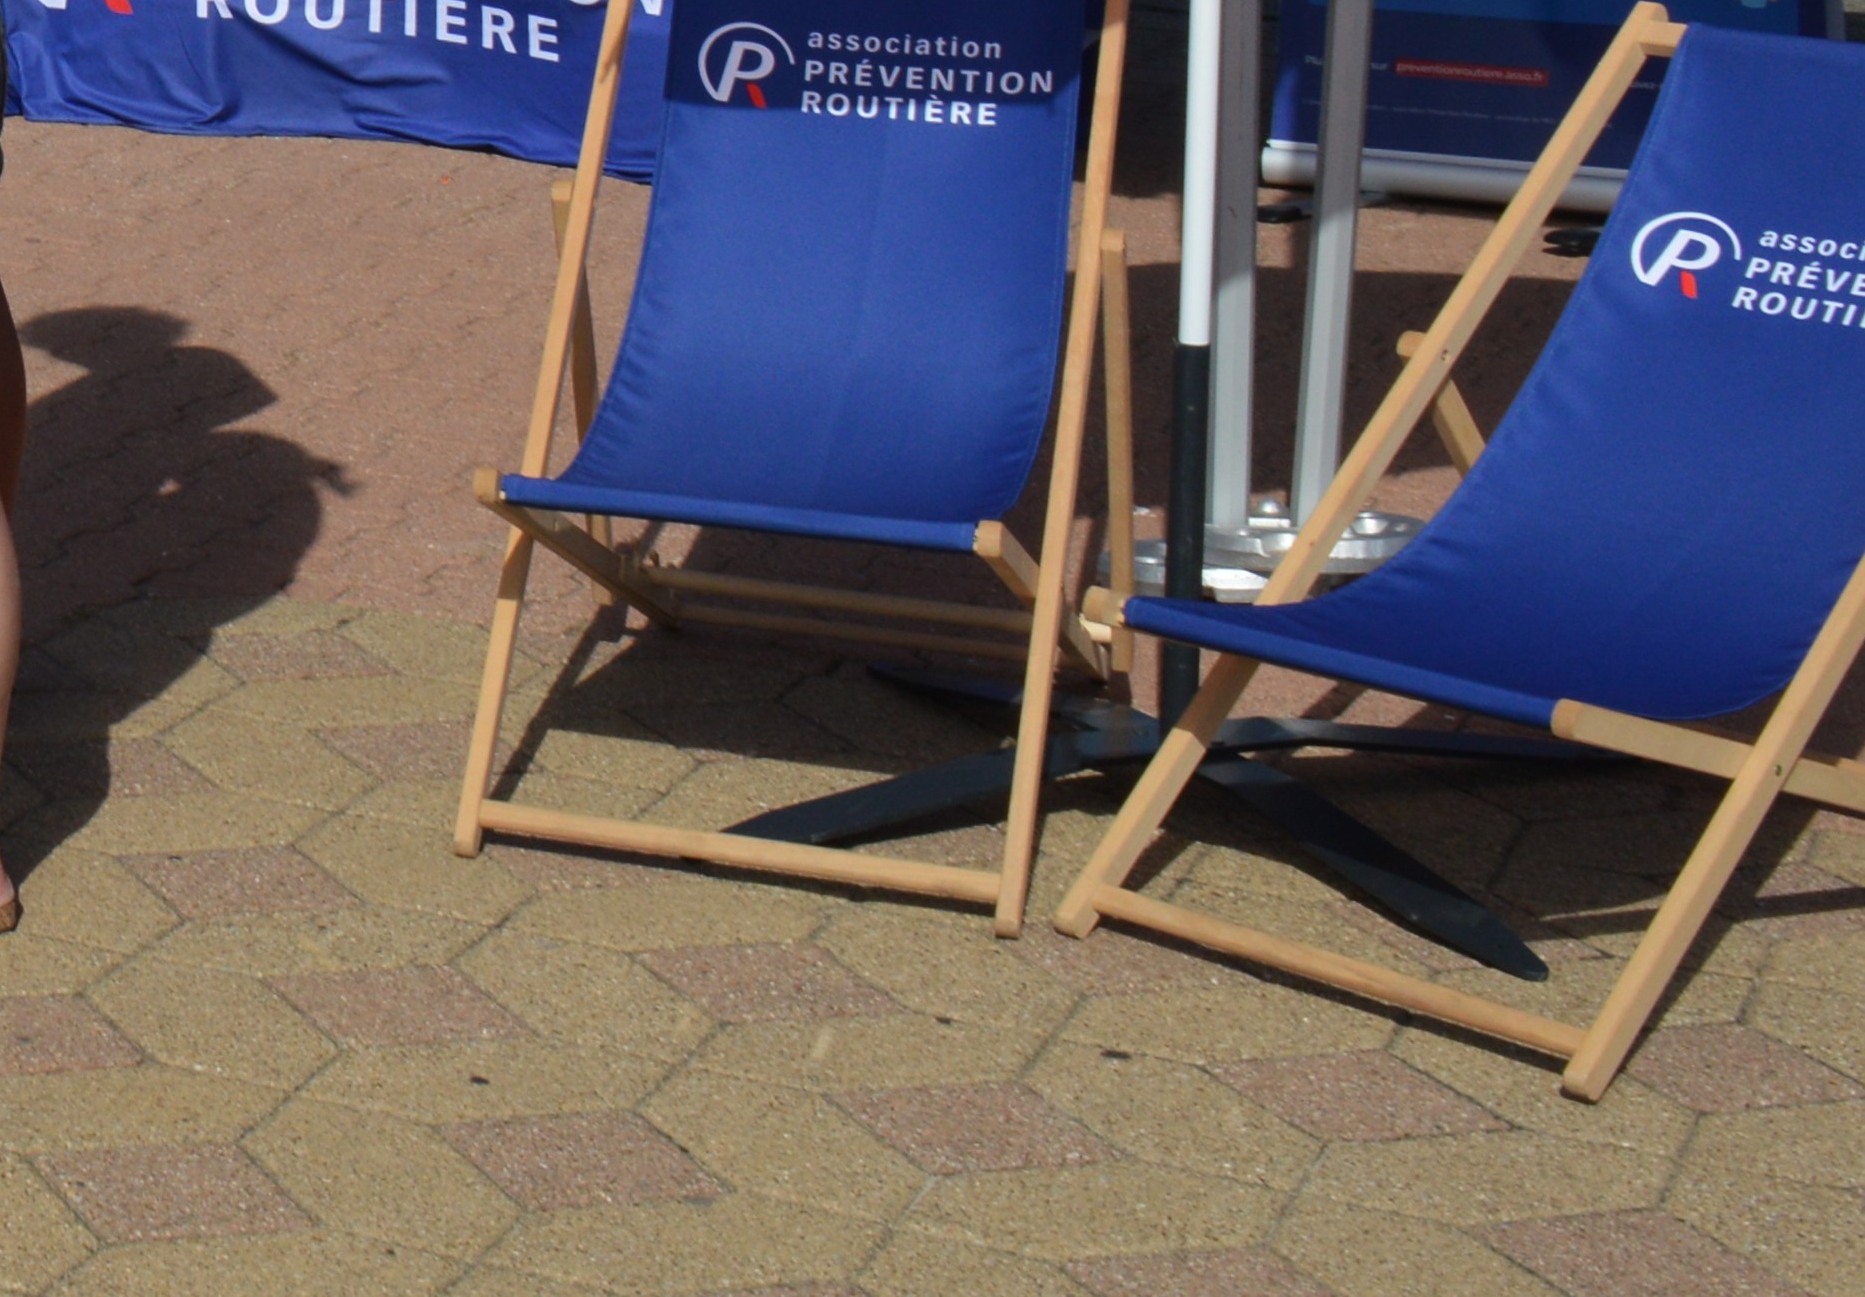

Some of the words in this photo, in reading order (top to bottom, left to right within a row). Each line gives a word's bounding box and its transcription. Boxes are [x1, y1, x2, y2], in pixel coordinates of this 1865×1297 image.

[807, 31, 1002, 59] association
[804, 58, 1053, 95] PRÉVENTION
[801, 90, 998, 126] ROUTIÈRE
